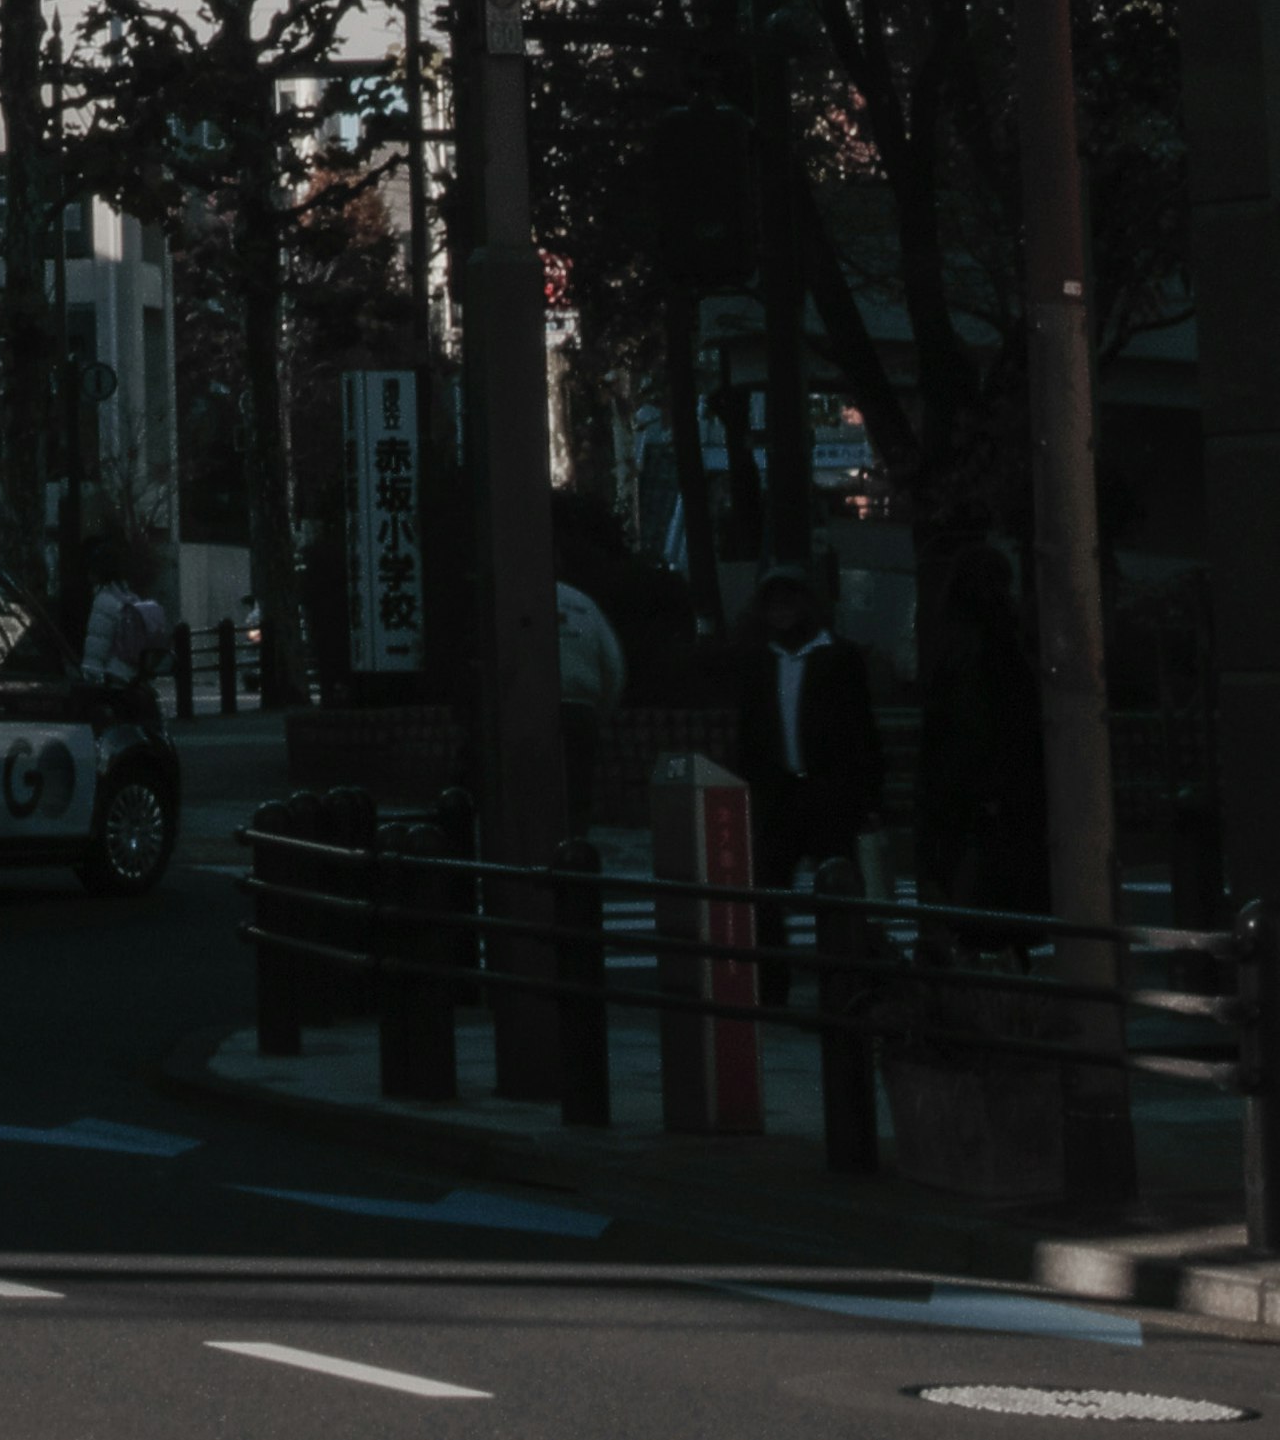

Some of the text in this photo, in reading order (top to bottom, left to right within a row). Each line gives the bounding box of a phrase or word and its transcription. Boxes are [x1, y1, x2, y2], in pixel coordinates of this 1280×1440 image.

[375, 436, 419, 631] 赤坂小学校
